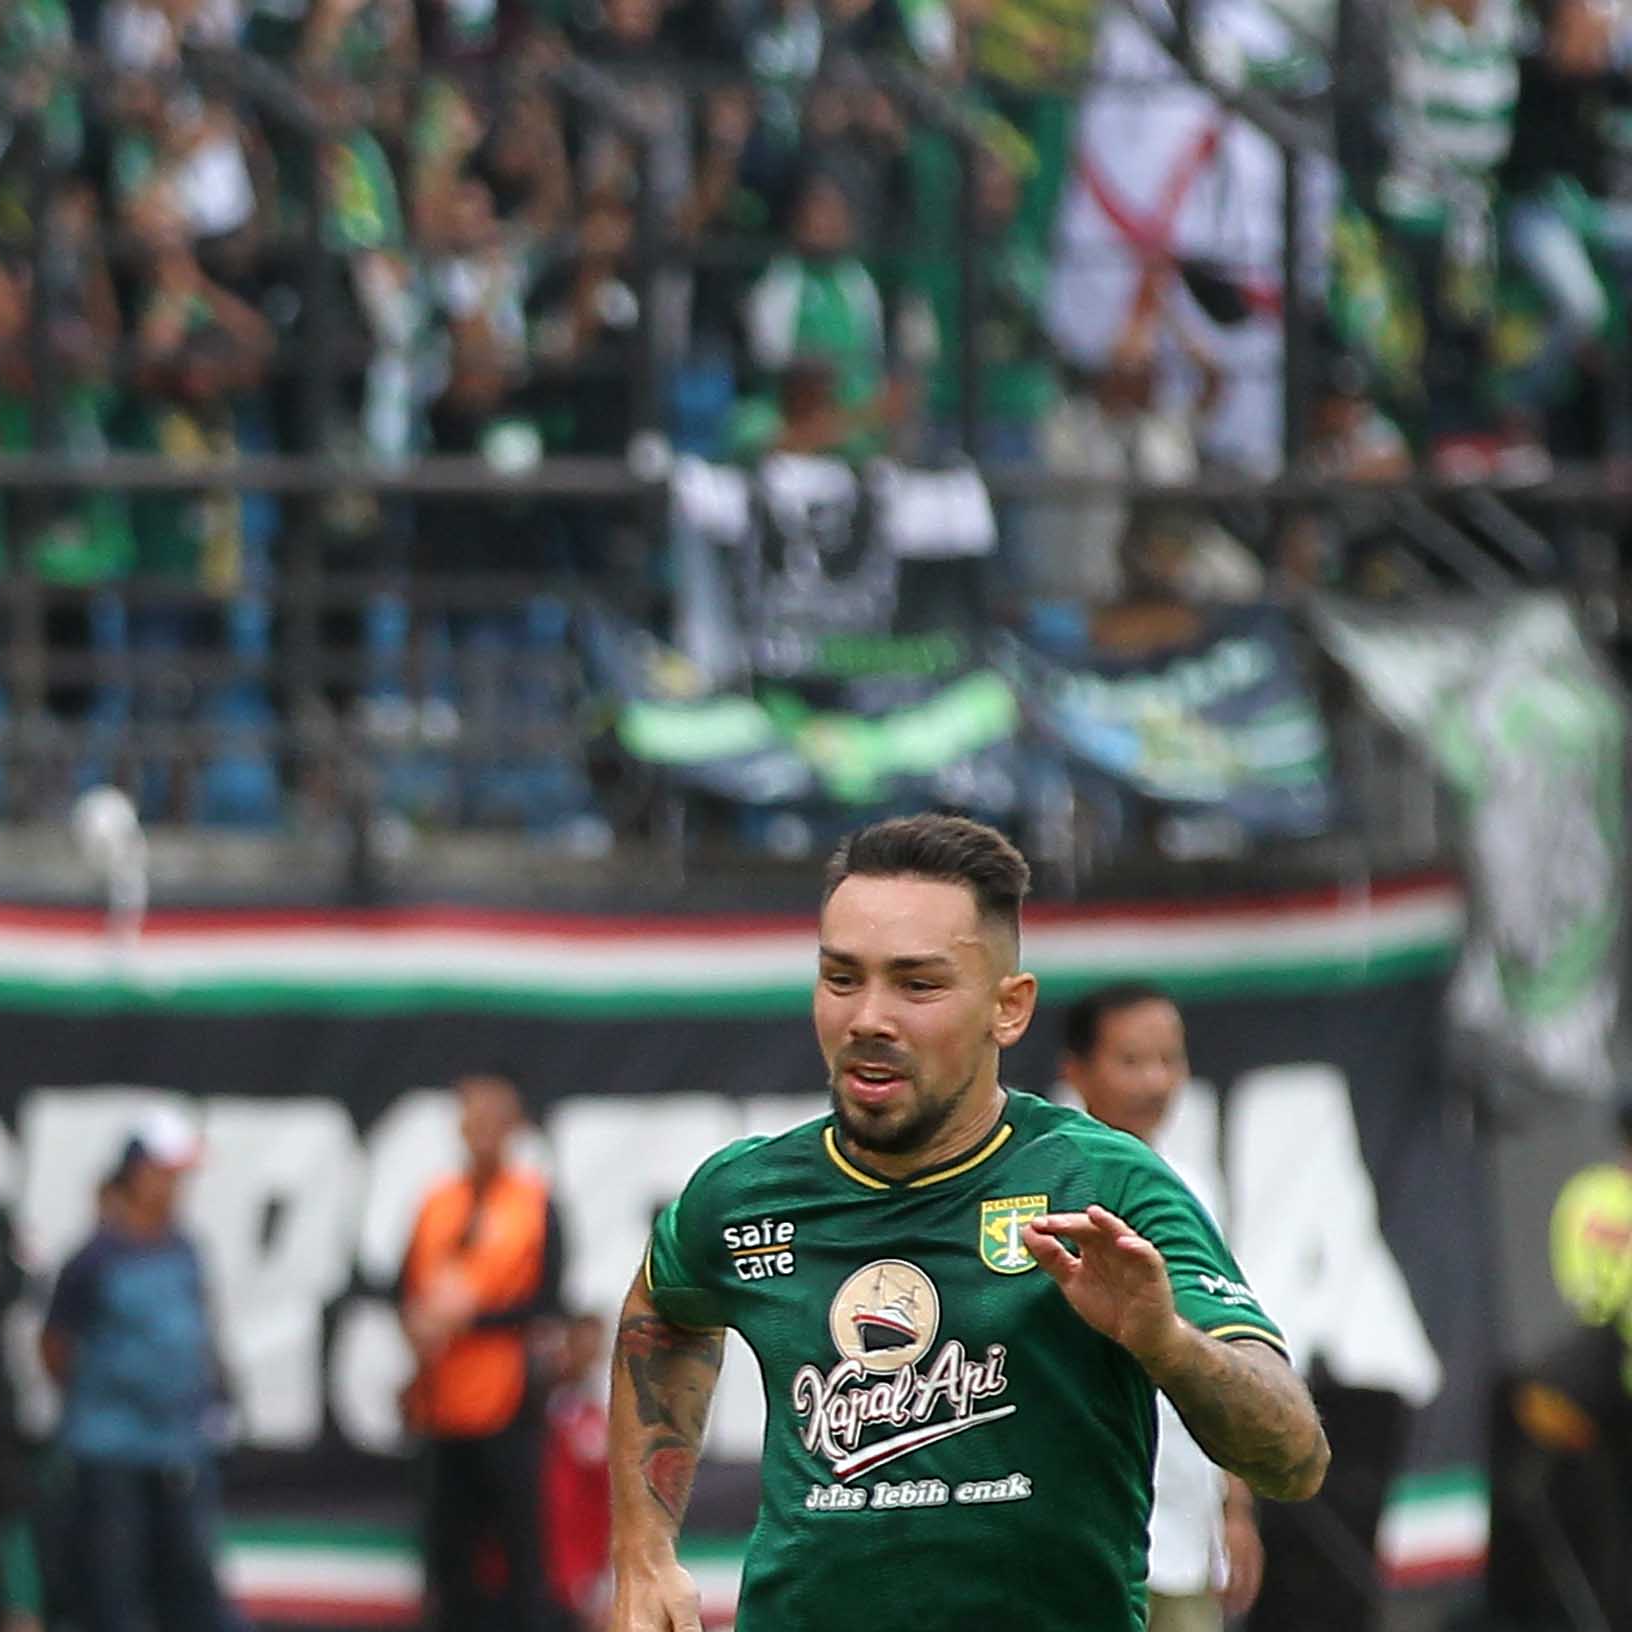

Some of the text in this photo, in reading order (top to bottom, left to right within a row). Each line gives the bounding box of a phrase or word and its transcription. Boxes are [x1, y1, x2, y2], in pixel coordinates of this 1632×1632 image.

[723, 1218, 795, 1249] safe
[734, 1251, 795, 1281] care
[793, 1339, 1008, 1461] Kapal Api
[805, 1472, 1033, 1511] Jelas lebih enak
